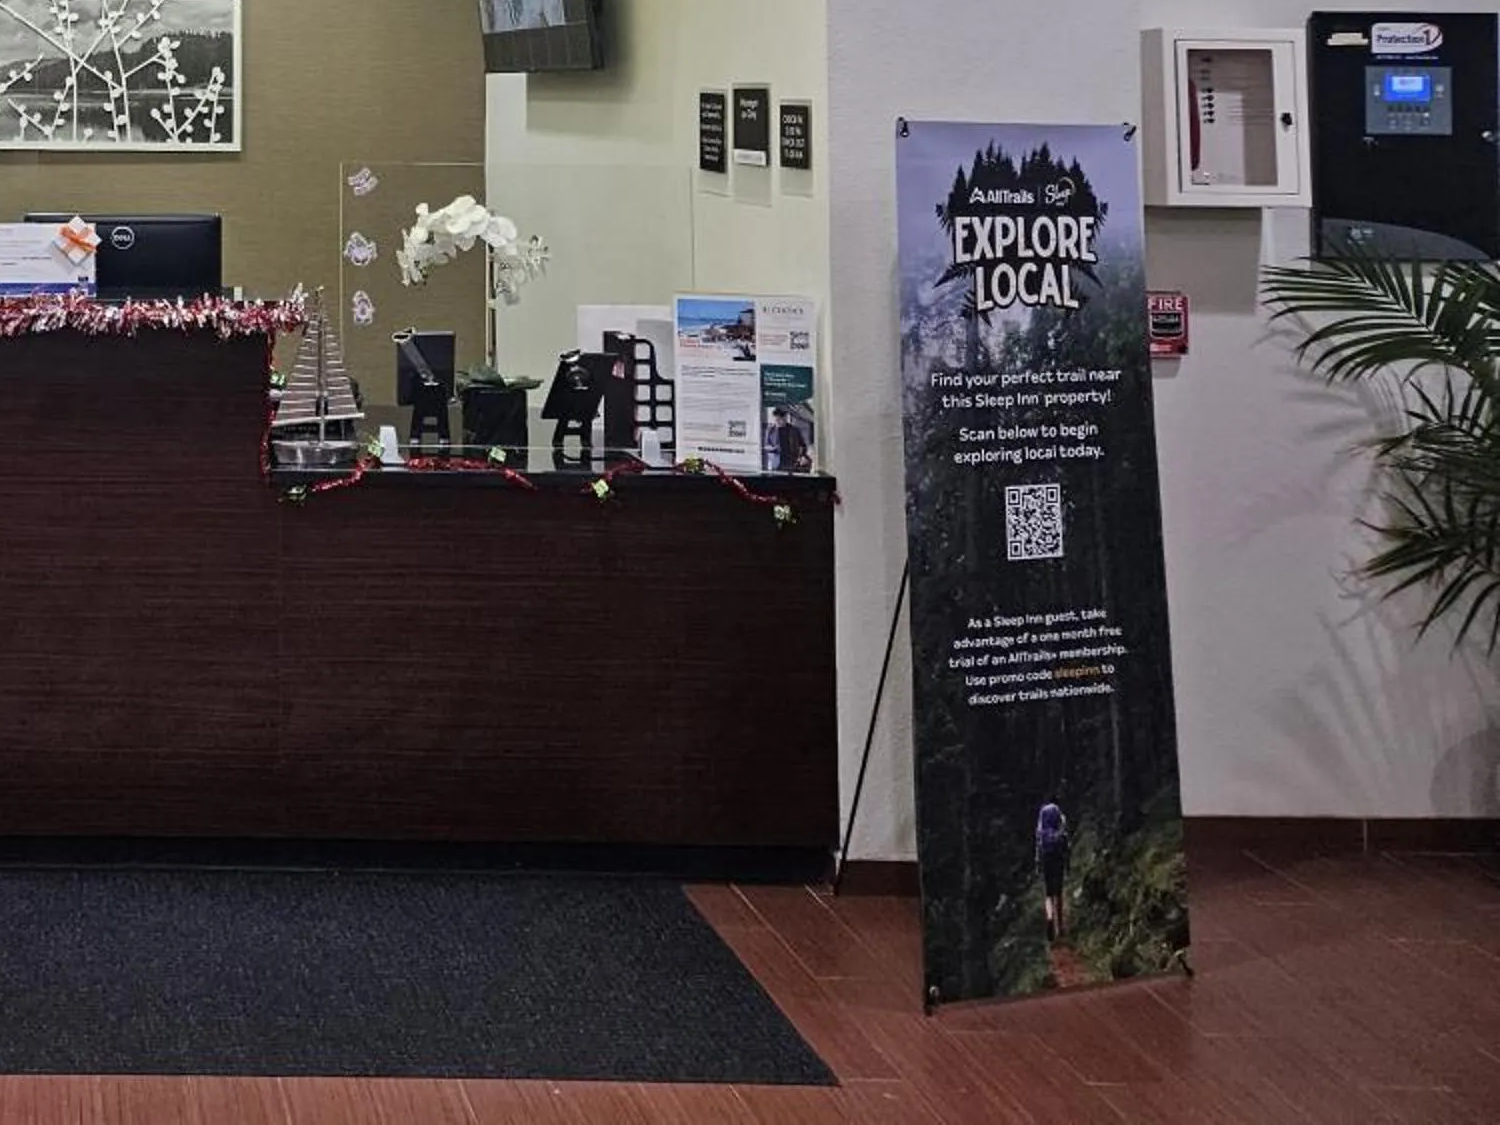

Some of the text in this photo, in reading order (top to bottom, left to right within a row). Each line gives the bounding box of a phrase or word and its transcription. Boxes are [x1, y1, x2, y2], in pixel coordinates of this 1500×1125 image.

[987, 189, 1035, 204] AllTrails
[954, 215, 1098, 264] EXPLORE
[974, 262, 1080, 312] LOCAL
[1147, 297, 1184, 311] FIRE
[931, 368, 1122, 389] Find your perfect trail near
[942, 392, 972, 408] this
[975, 392, 1014, 409] Sleep
[1044, 388, 1112, 408] property!
[959, 420, 1099, 442] Scan below to begin
[953, 442, 1105, 466] exploring local today.
[967, 618, 983, 628] As
[984, 619, 992, 628] a
[994, 615, 1024, 627] Sleep
[1025, 614, 1044, 624] Inn
[1081, 608, 1107, 620] take
[953, 625, 1123, 650] advantage of a one month free
[948, 656, 975, 668] trial
[976, 654, 990, 666] of
[991, 655, 1007, 666] an
[965, 676, 986, 686] Use
[989, 673, 1024, 687] promo
[1026, 669, 1052, 681] code
[1101, 663, 1115, 674] to
[967, 682, 1115, 706] discover trails nationwide.
